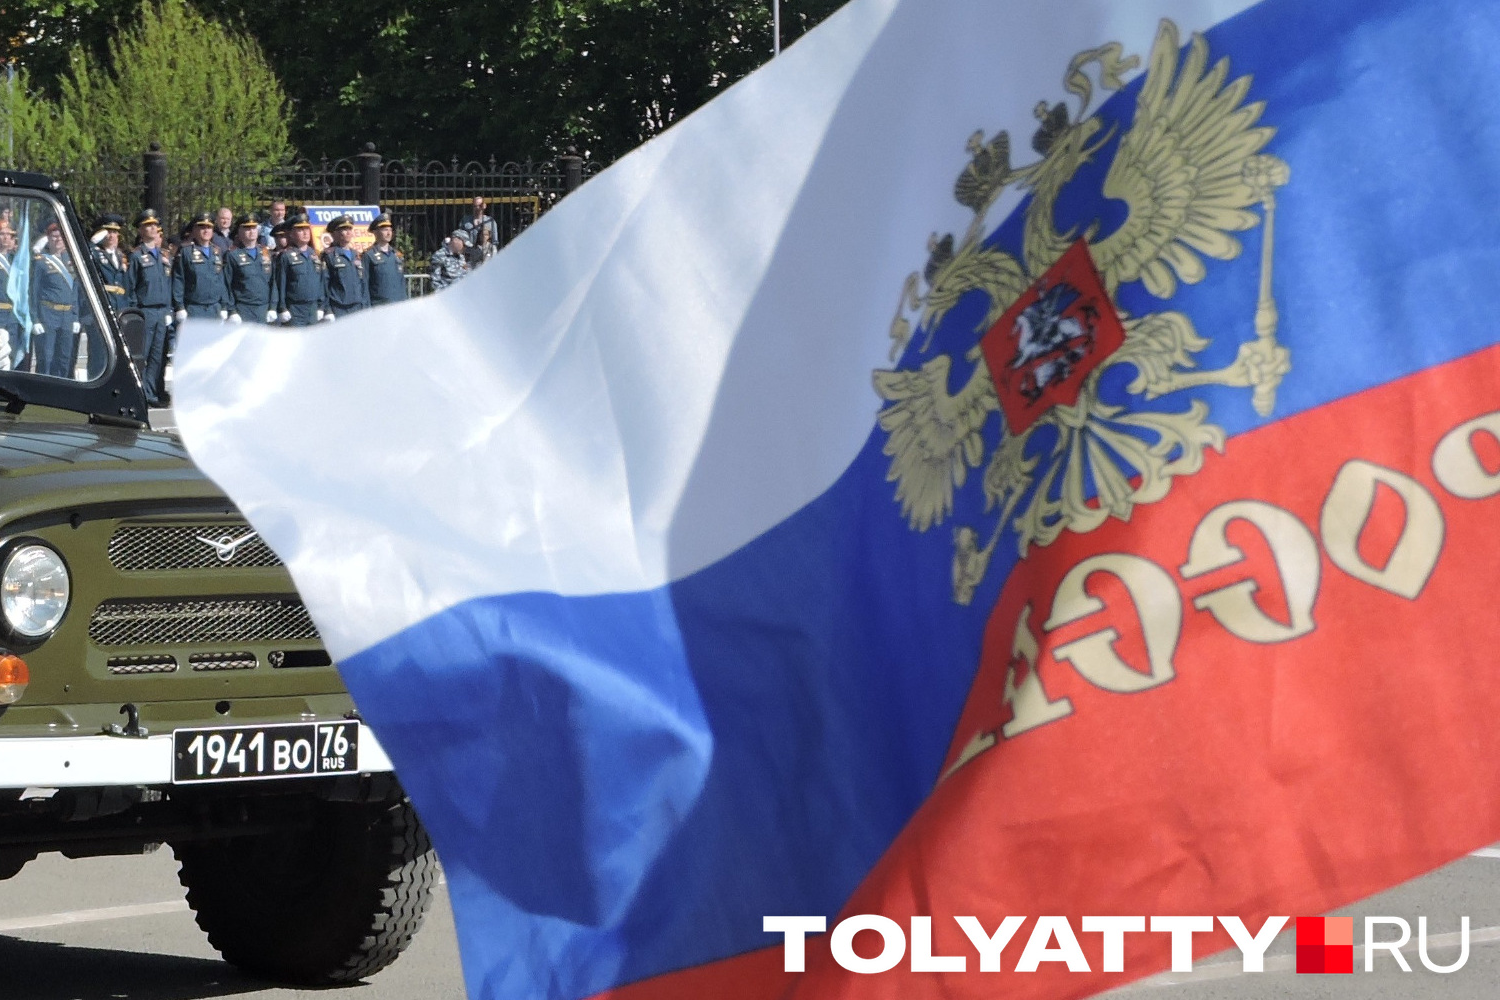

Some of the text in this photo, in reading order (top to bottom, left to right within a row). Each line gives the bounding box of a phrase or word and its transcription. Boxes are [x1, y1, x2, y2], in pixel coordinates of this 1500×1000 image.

[187, 732, 265, 775] 1941
[319, 726, 349, 756] 76
[322, 757, 346, 770] RUS
